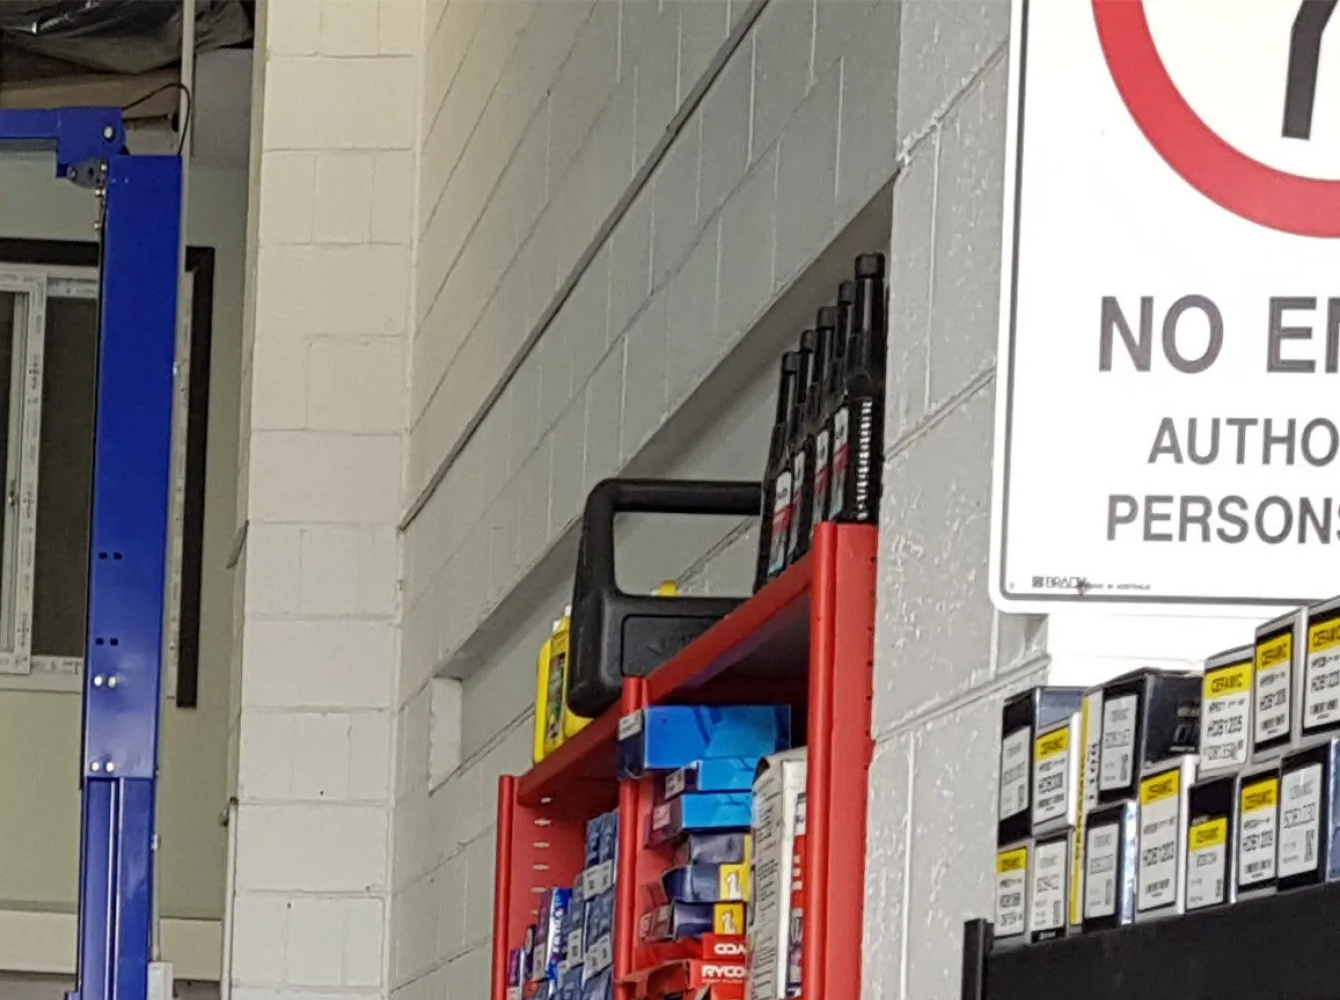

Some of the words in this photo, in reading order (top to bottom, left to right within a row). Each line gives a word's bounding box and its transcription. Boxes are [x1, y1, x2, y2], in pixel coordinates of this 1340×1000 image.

[1099, 294, 1224, 374] NO
[1147, 417, 1339, 467] AUTHO
[1107, 494, 1340, 545] PERSON
